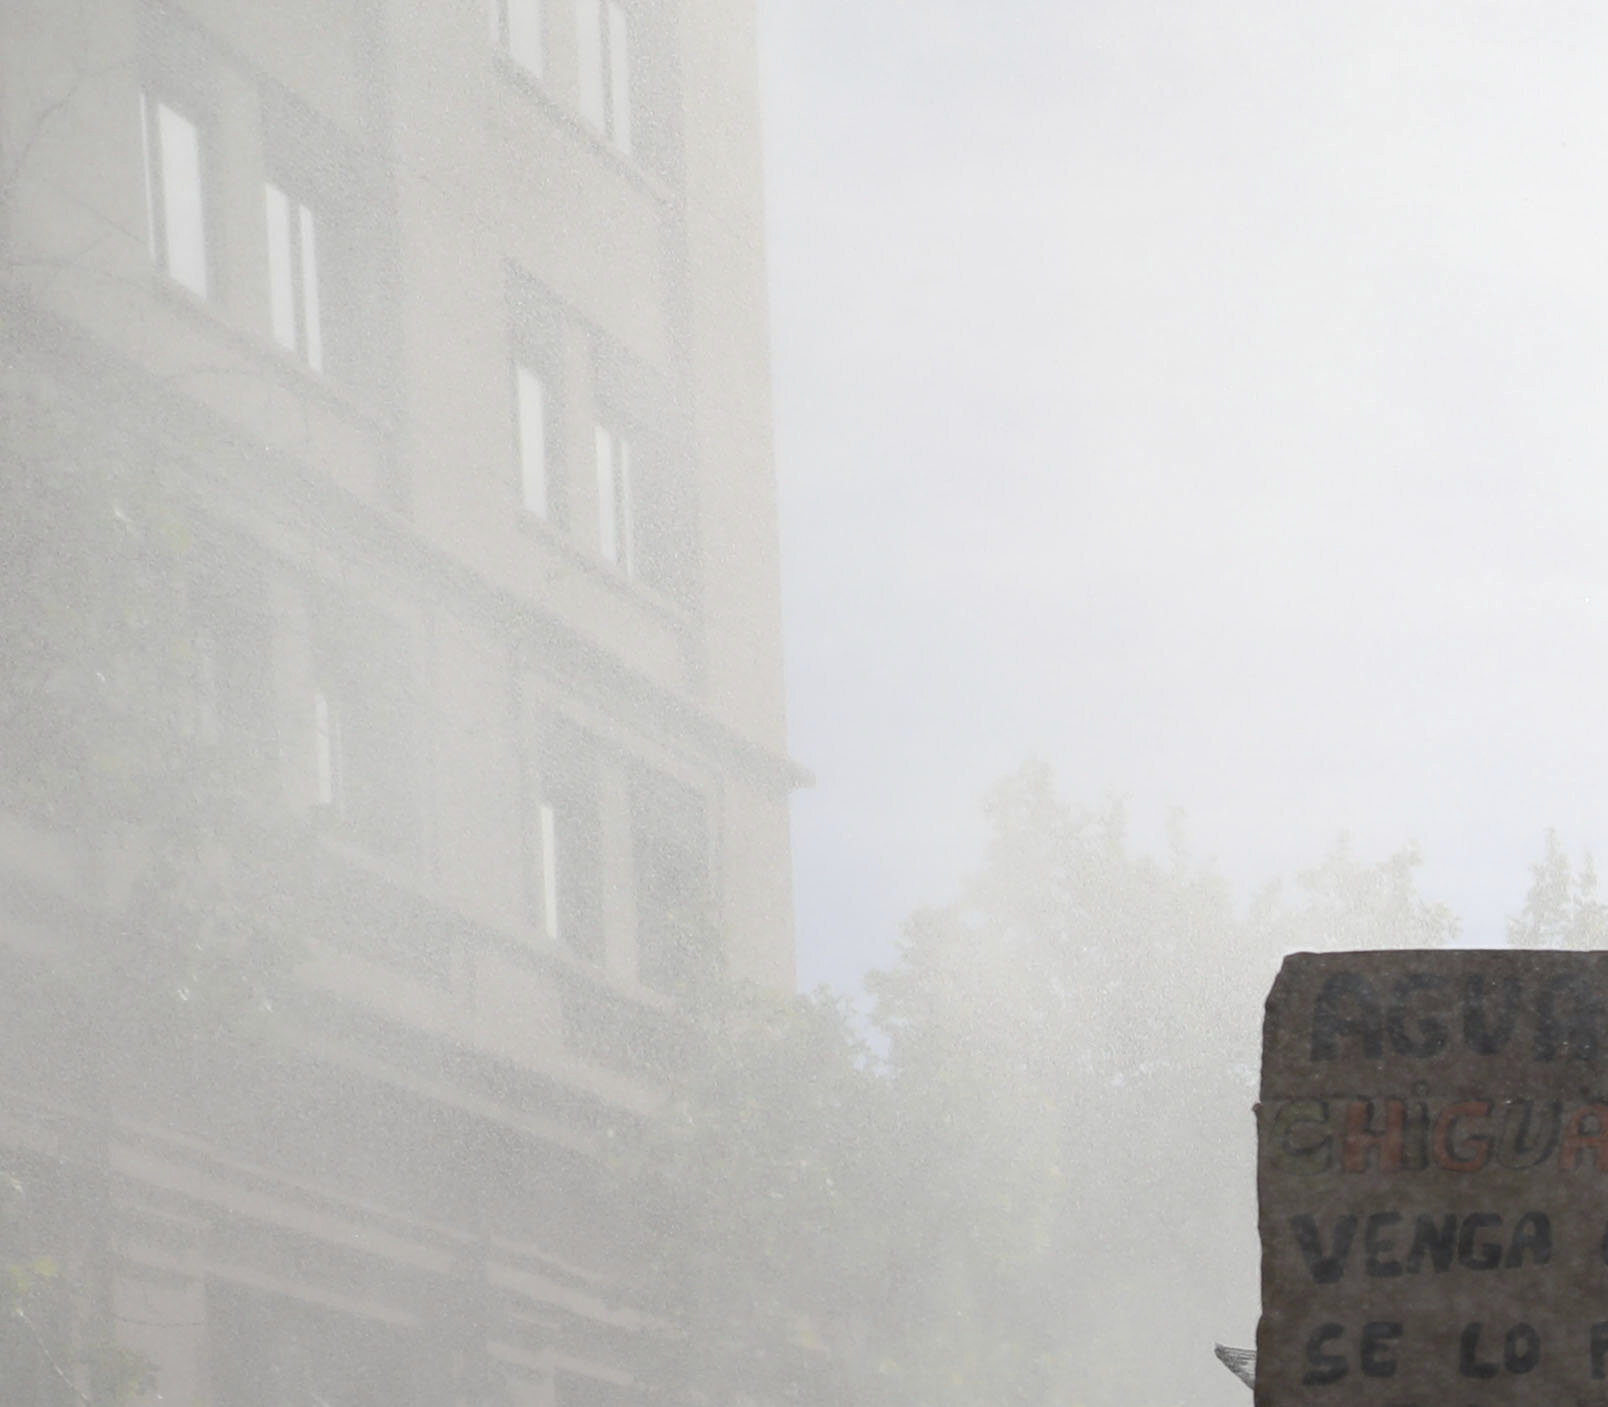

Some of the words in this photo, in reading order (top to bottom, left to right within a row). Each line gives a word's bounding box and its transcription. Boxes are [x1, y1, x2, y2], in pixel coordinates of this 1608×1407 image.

[1287, 1210, 1553, 1286] VENGA
[1301, 1320, 1405, 1387] SE
[1458, 1321, 1543, 1382] LO
